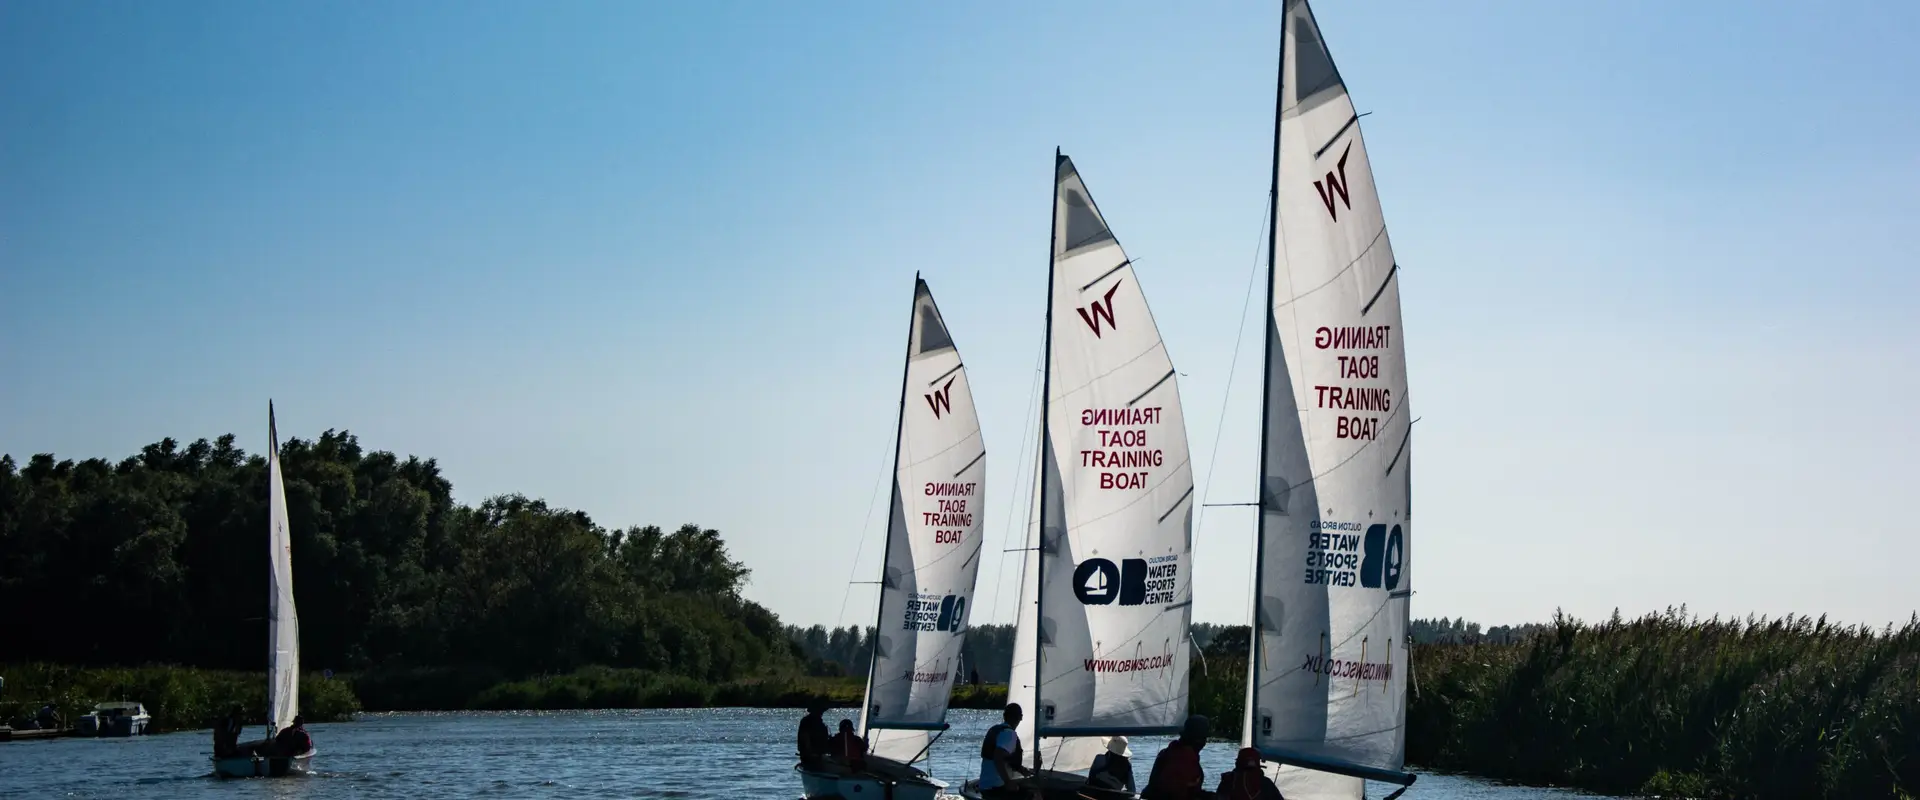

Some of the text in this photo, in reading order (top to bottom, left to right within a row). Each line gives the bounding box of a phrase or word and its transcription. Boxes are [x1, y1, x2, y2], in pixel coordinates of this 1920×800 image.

[1314, 385, 1390, 412] TRAINING
[1336, 416, 1378, 441] BOAT
[1081, 450, 1163, 468] TRAINING
[1100, 472, 1148, 490] BOAT
[923, 512, 972, 527] TRAINING
[935, 530, 962, 544] BOAT
[1149, 563, 1177, 579] WATER
[1146, 578, 1175, 592] SPORTS
[1144, 592, 1174, 605] CENTRE
[1084, 653, 1173, 674] WWW.OBWSC.CO.UK
